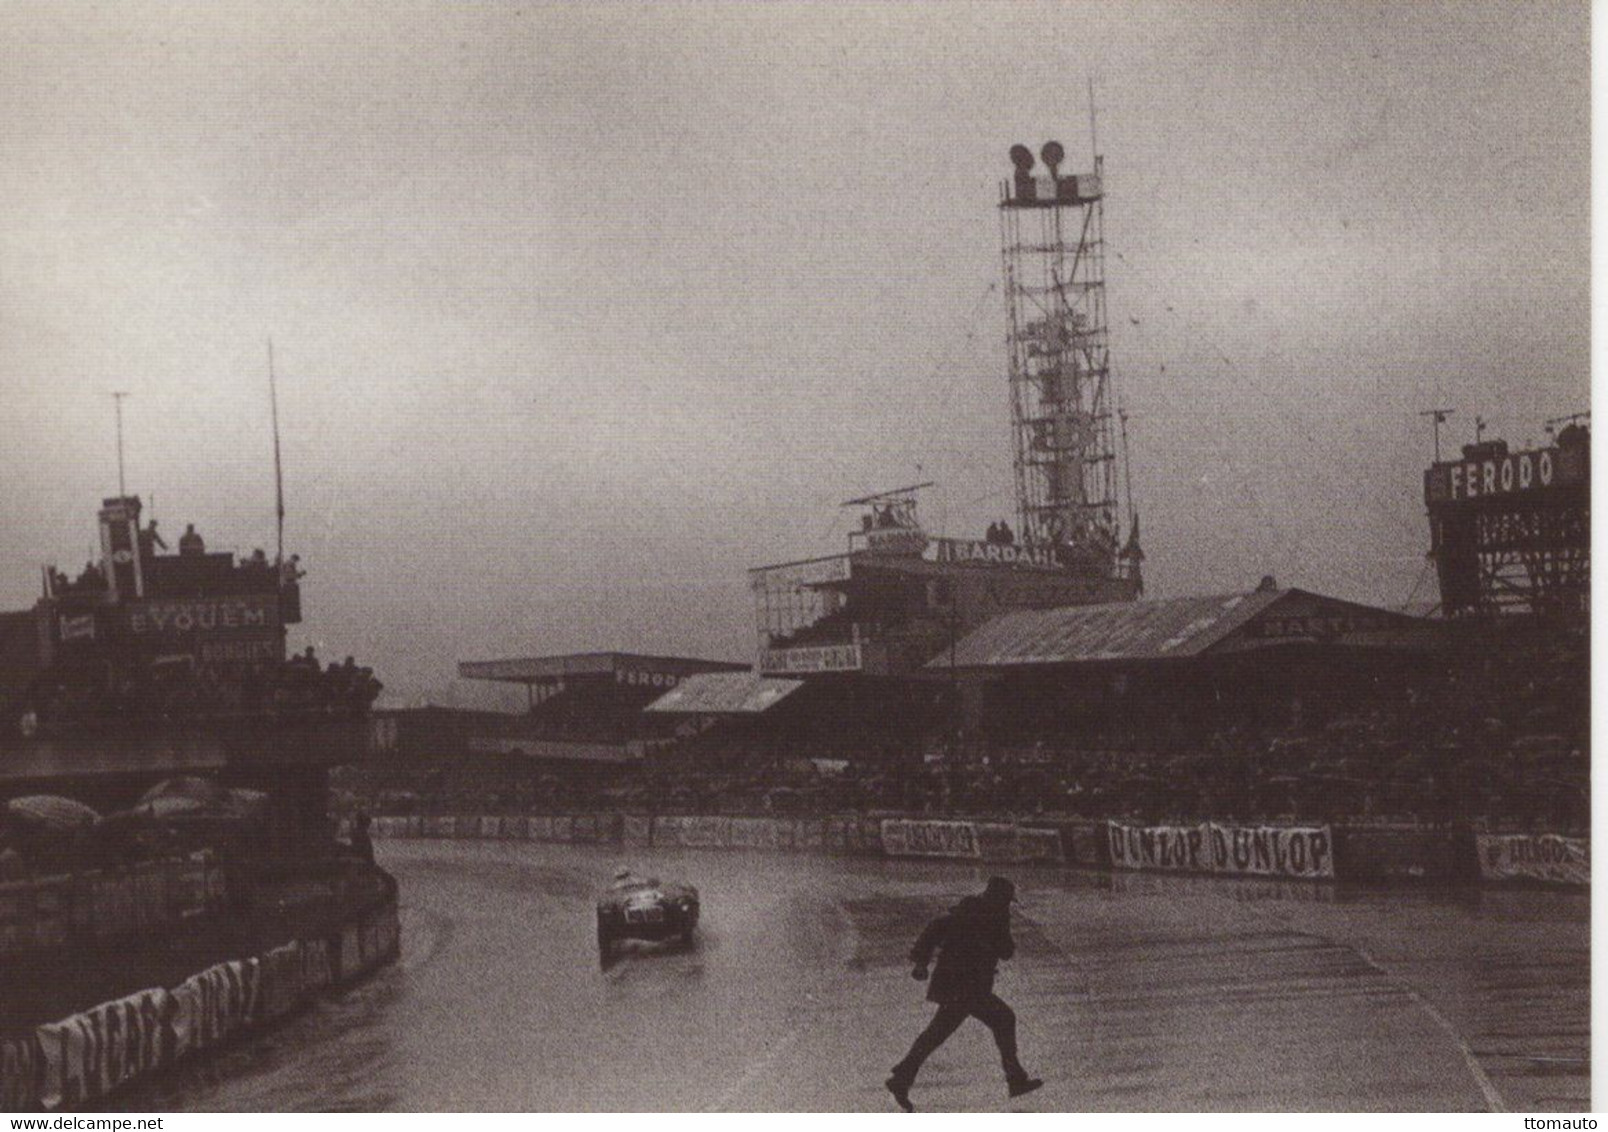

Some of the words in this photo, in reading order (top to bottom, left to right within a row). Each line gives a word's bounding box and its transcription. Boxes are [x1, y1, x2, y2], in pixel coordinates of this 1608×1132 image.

[1451, 450, 1553, 500] FERODO
[955, 541, 1064, 568] BARDAHL
[131, 608, 264, 632] EYQUEM
[1111, 826, 1202, 867] DUNLOP
[1211, 828, 1328, 873] DUNLOP
